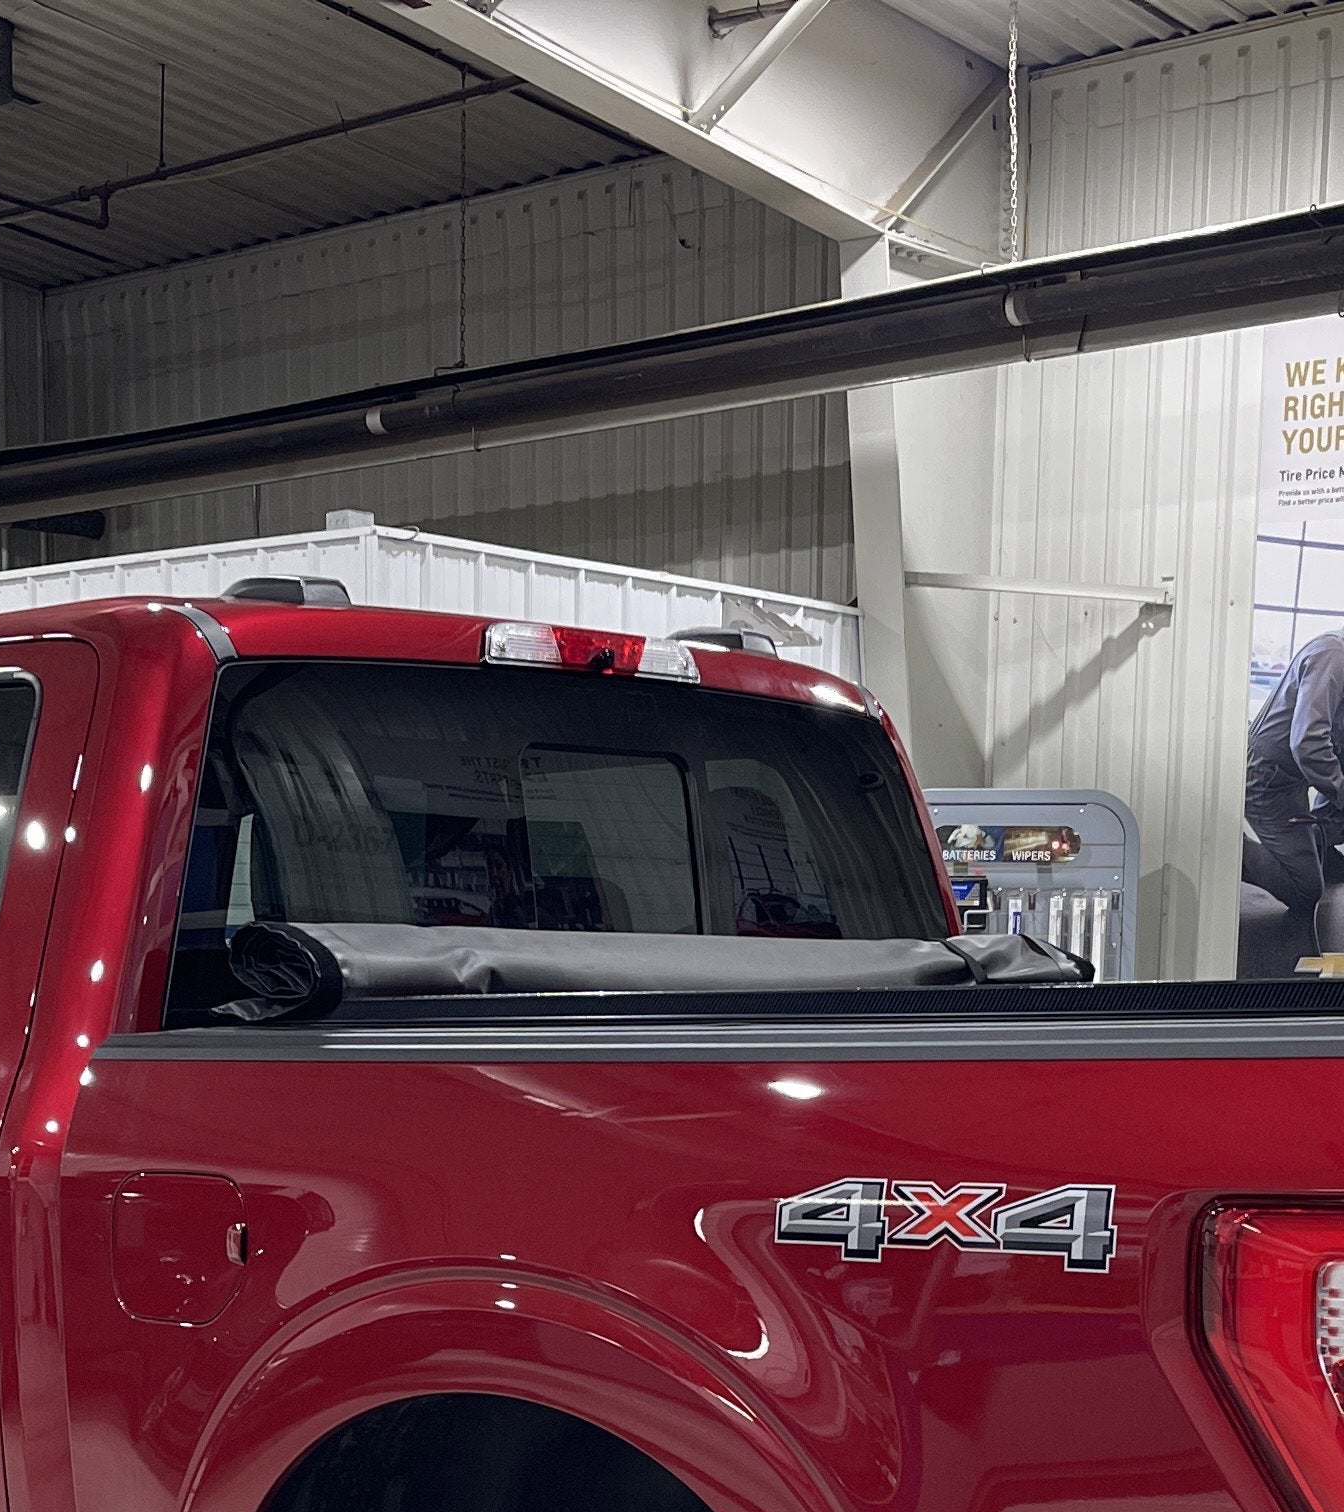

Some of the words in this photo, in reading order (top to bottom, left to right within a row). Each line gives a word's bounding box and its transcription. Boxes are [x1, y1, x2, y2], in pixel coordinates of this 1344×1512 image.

[1285, 359, 1326, 387] WE
[1280, 470, 1301, 482] Tire
[1306, 467, 1335, 480] Price
[943, 850, 996, 860] BATTERIES
[1012, 850, 1051, 861] WIPERS
